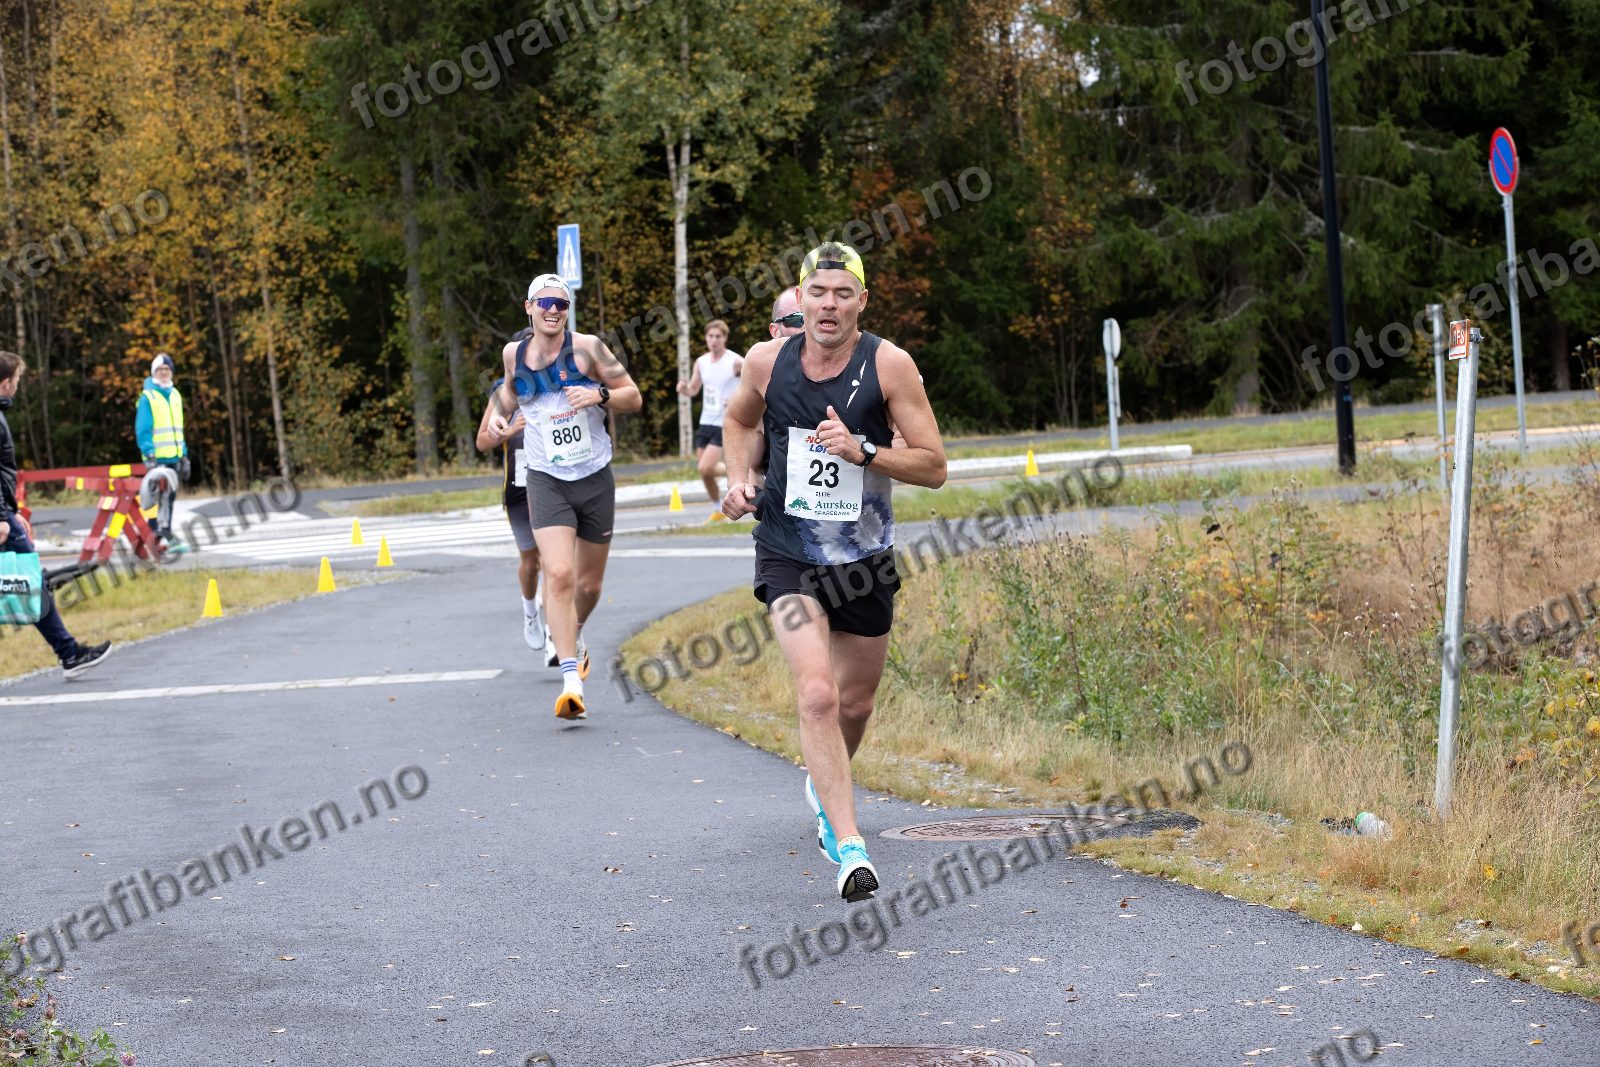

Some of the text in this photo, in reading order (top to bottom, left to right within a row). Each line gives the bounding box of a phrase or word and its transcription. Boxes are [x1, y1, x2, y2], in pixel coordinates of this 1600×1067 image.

[552, 425, 581, 446] 880
[808, 459, 840, 489] 23
[815, 499, 859, 513] Aurskog
